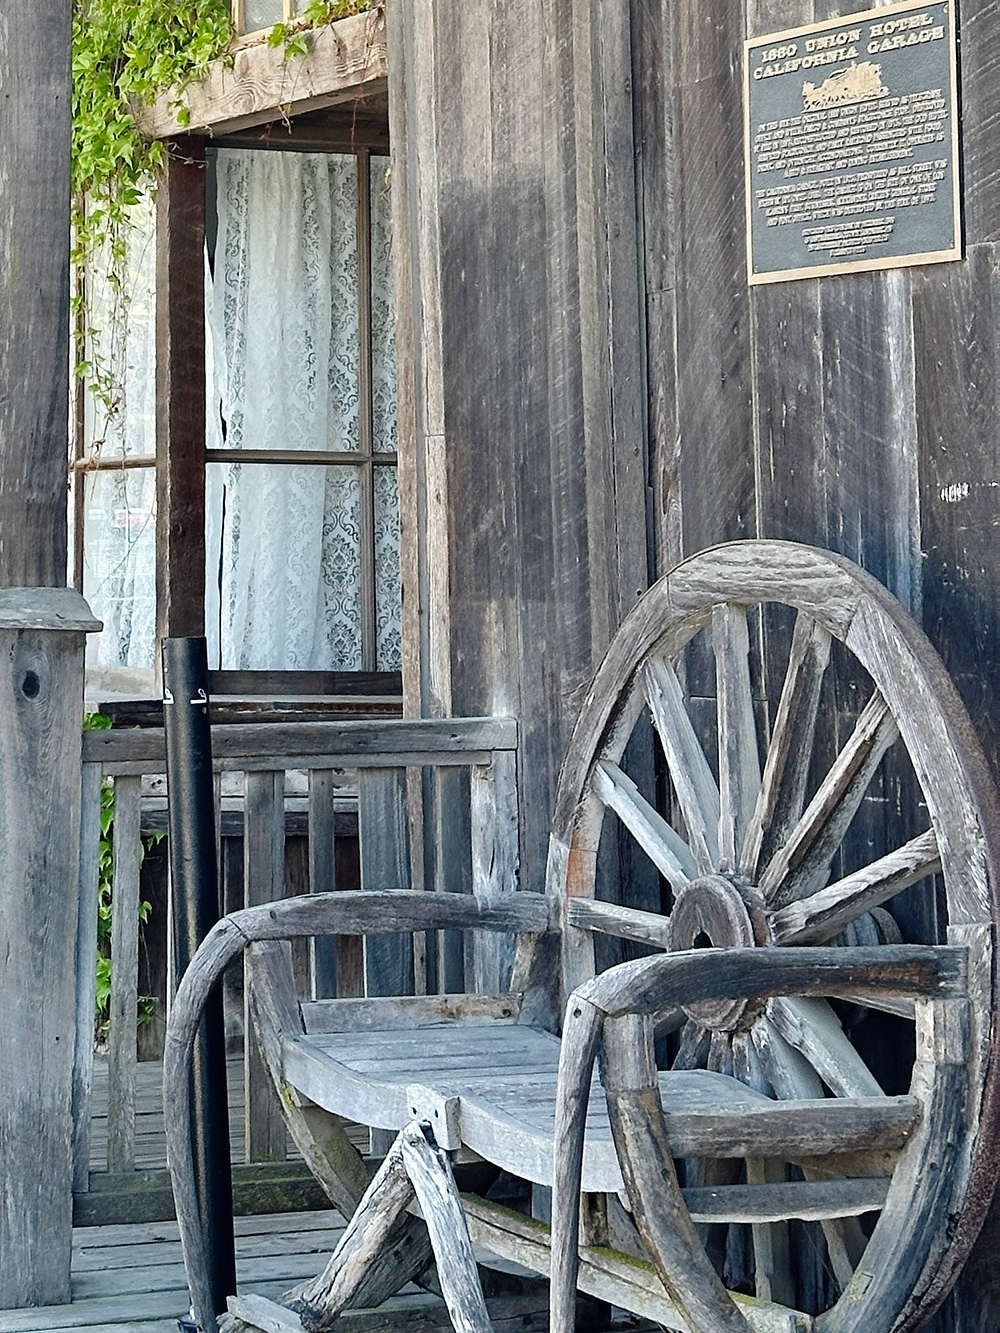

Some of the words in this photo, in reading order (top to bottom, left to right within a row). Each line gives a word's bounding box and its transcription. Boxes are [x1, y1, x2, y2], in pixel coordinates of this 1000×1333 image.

[753, 47, 859, 80] CALIFORNIA
[867, 26, 944, 55] GARAGE
[762, 43, 797, 62] 1880
[805, 28, 862, 53] UNION
[870, 13, 933, 38] HOTEL
